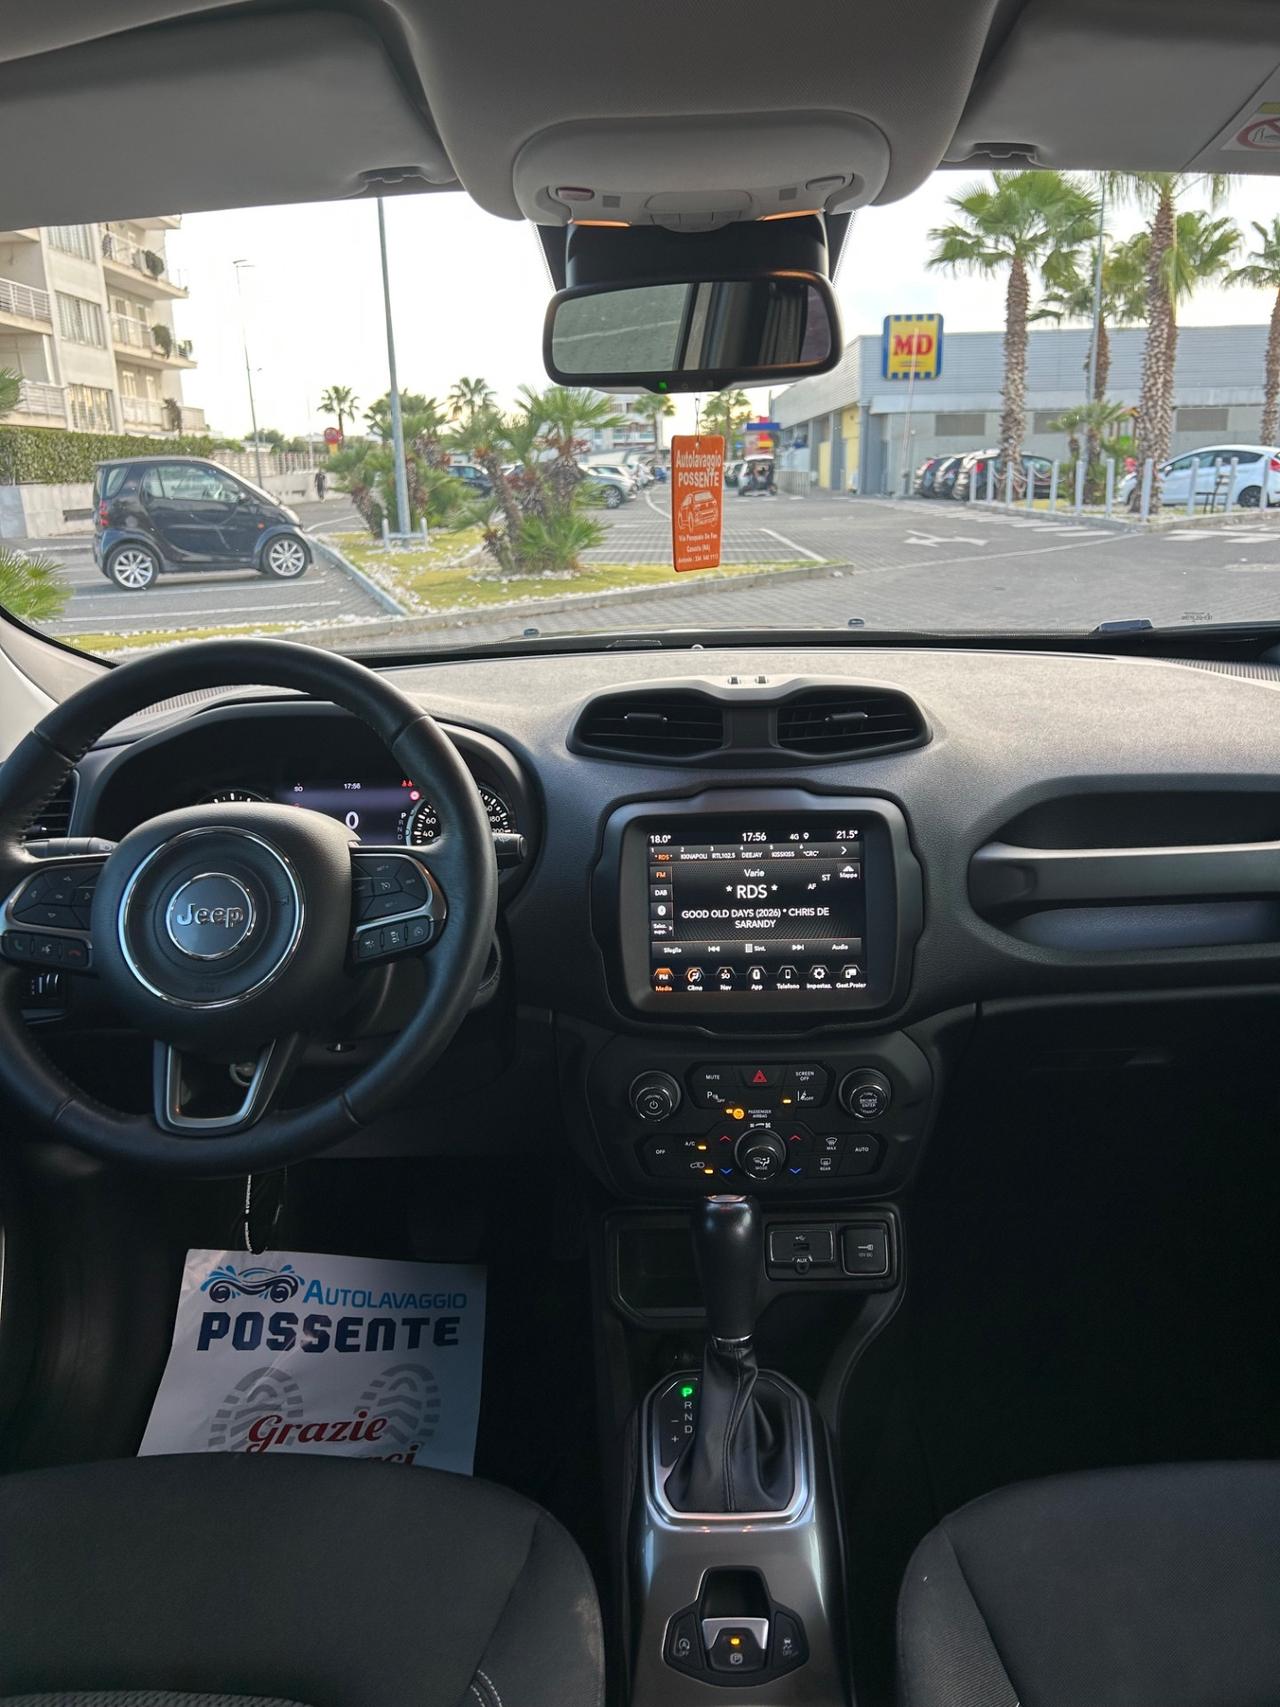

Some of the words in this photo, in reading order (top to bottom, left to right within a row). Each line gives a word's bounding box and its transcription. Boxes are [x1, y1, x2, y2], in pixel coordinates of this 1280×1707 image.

[893, 334, 933, 356] MD
[676, 450, 722, 473] Autolavaggio
[678, 471, 720, 488] POSSENTE
[345, 811, 360, 830] 0
[425, 817, 437, 825] 60
[742, 832, 767, 842] 17:56
[836, 830, 858, 839] 21.5°
[736, 885, 768, 899] RDS
[176, 904, 244, 928] Jeep
[681, 910, 709, 919] GOOD
[710, 909, 729, 919] OLD
[731, 909, 754, 918] DAYS
[755, 907, 781, 919] (2026)
[788, 908, 815, 917] CHRIS
[817, 907, 830, 916] DE
[735, 920, 776, 929] SARANDY
[303, 1280, 467, 1310] AUTOLAVAGGIO
[197, 1311, 460, 1353] POSSENTE
[682, 1387, 693, 1397] P
[684, 1401, 692, 1409] R
[684, 1413, 693, 1421] N
[246, 1410, 388, 1455] Grazie
[684, 1425, 693, 1434] D
